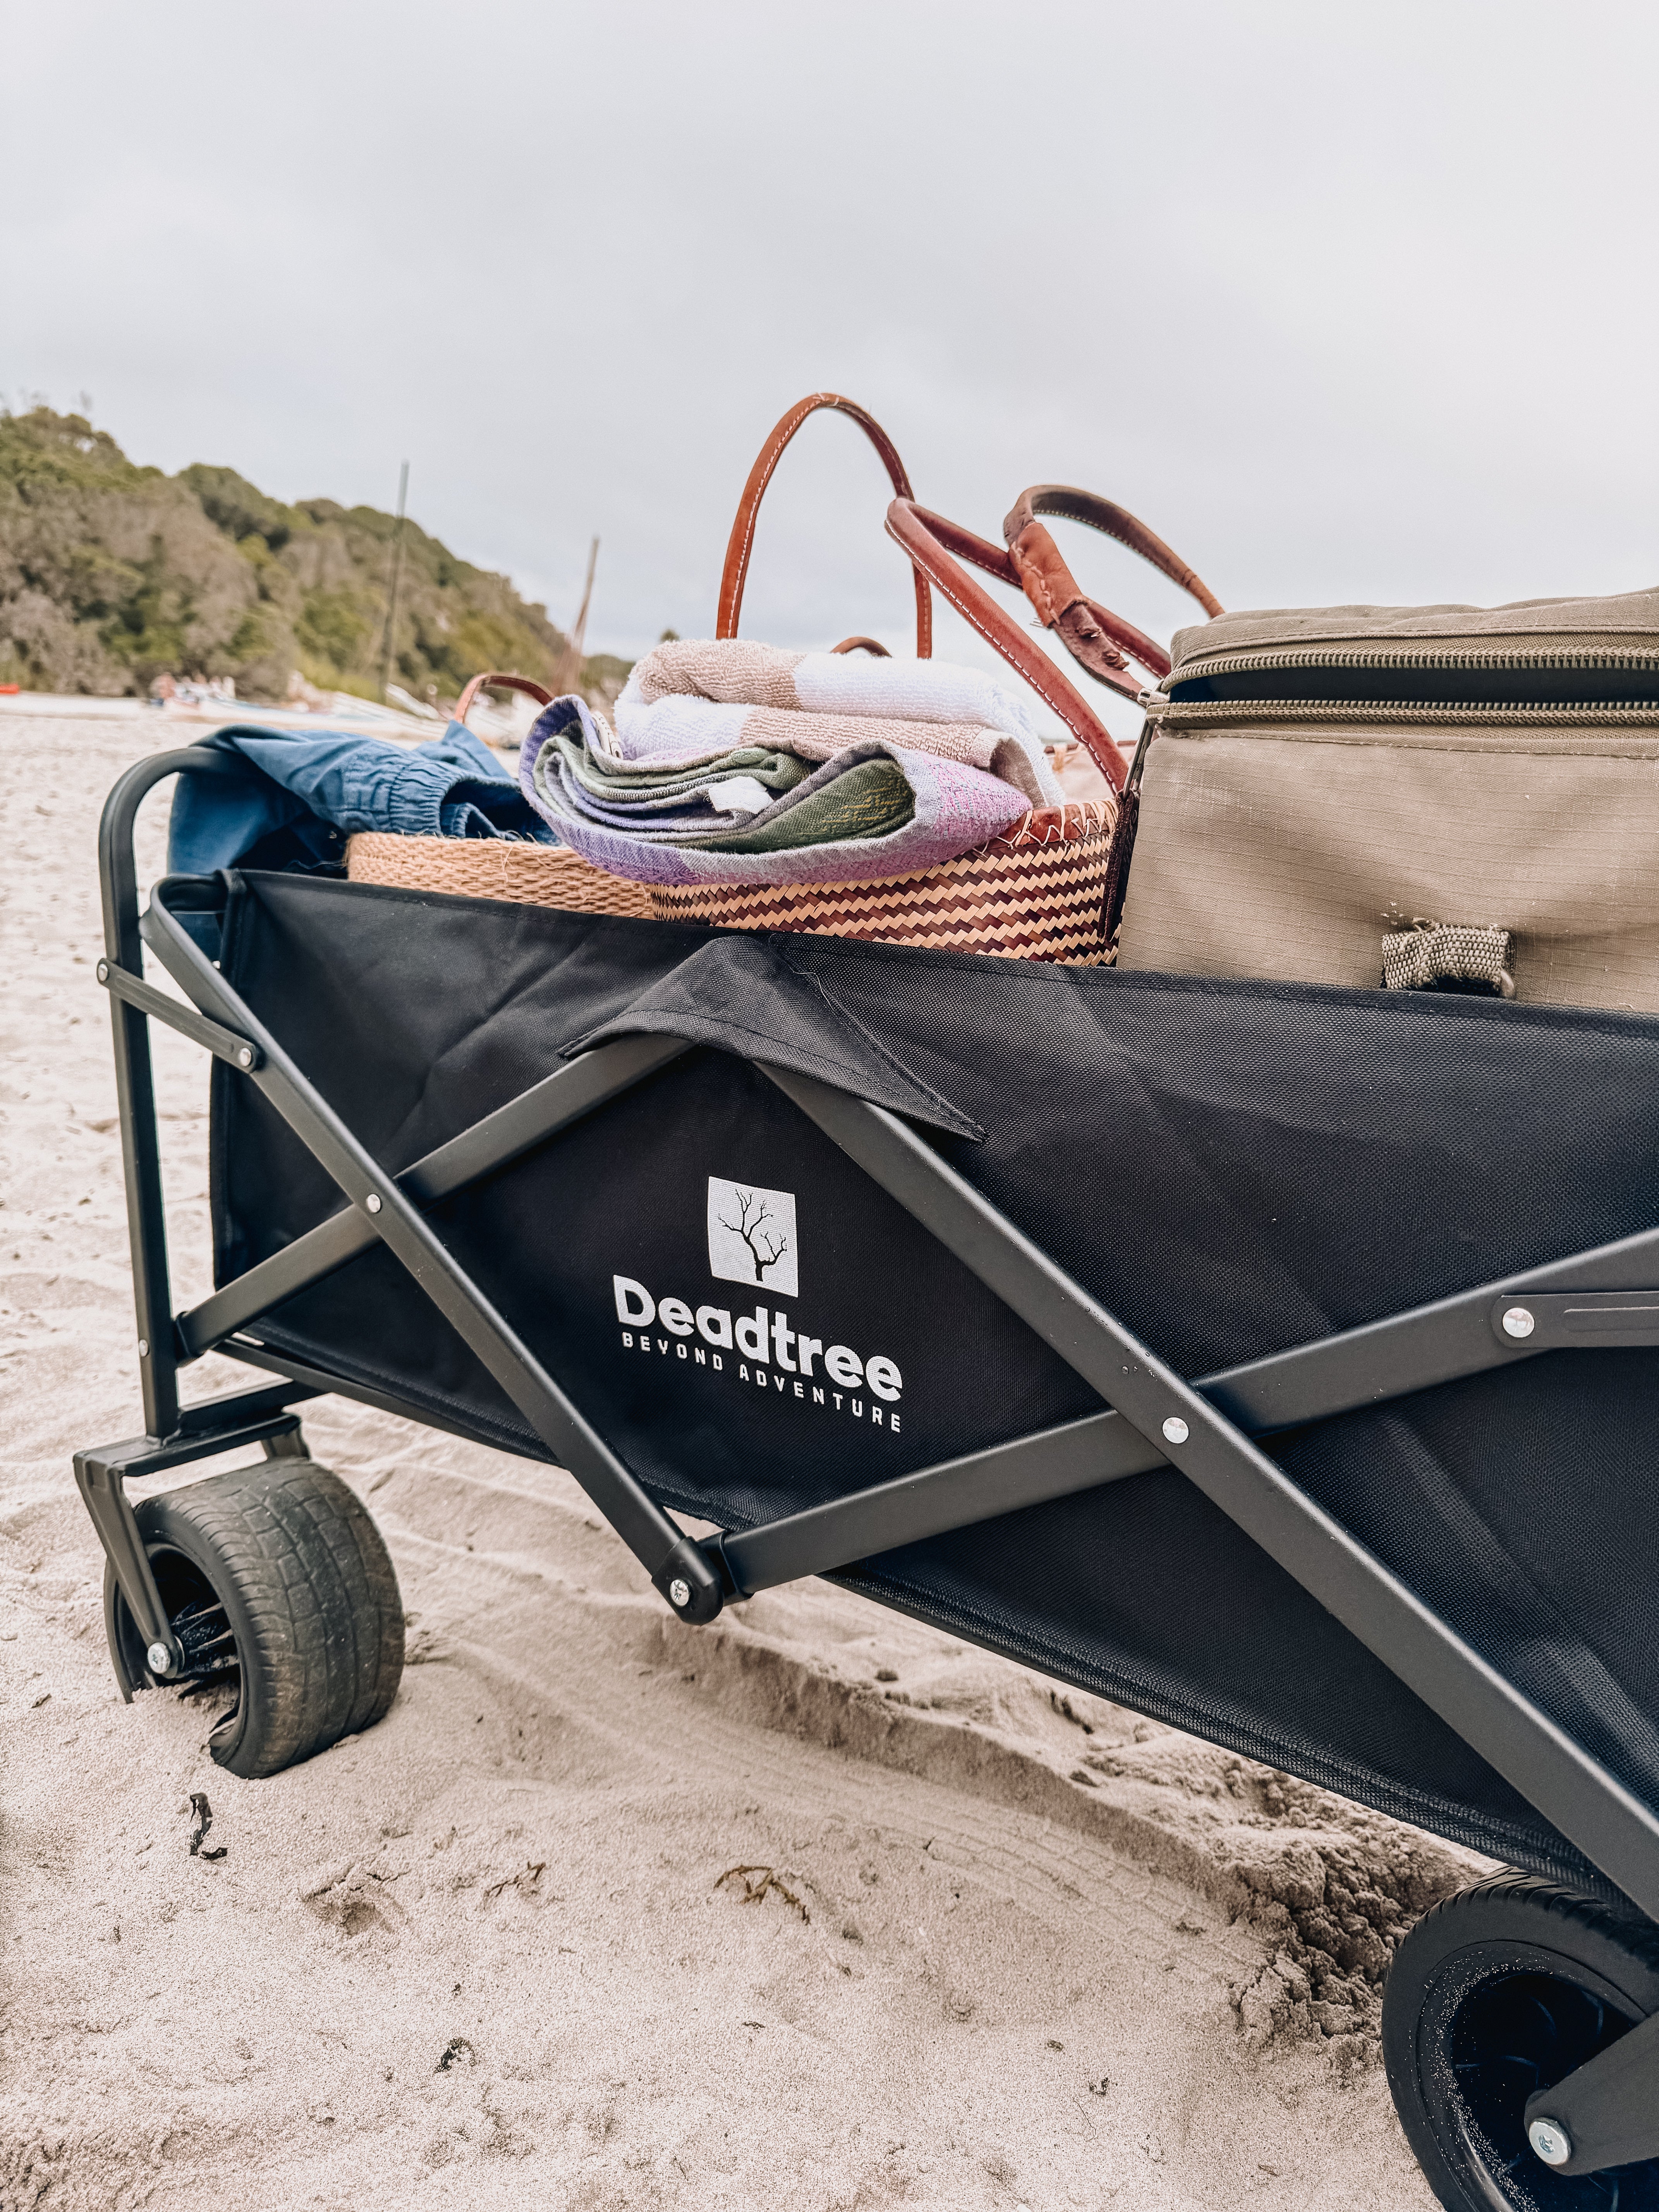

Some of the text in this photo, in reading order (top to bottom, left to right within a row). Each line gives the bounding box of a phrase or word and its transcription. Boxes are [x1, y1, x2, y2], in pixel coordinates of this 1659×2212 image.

[613, 1274, 903, 1401] Deadtree
[622, 1332, 900, 1433] BEYOND ADVENTURE
